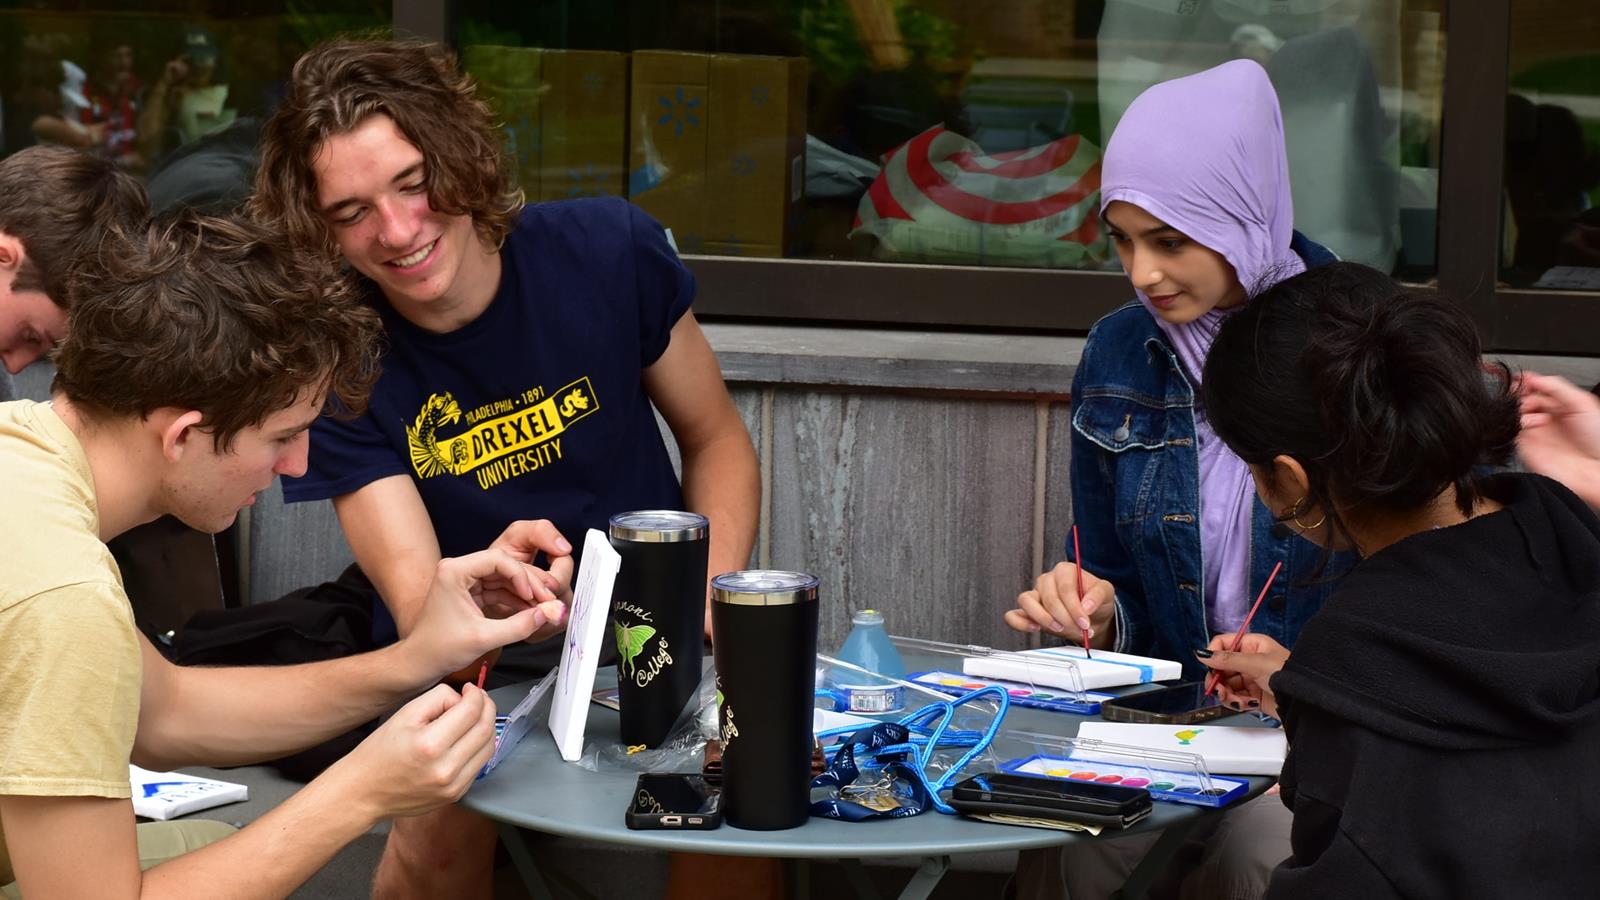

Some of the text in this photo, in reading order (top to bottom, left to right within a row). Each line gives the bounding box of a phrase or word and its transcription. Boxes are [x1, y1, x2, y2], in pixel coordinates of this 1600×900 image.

[521, 385, 545, 405] 1891
[472, 408, 556, 461] DREXEL
[476, 438, 563, 490] UNIVERSITY
[636, 636, 673, 688] College
